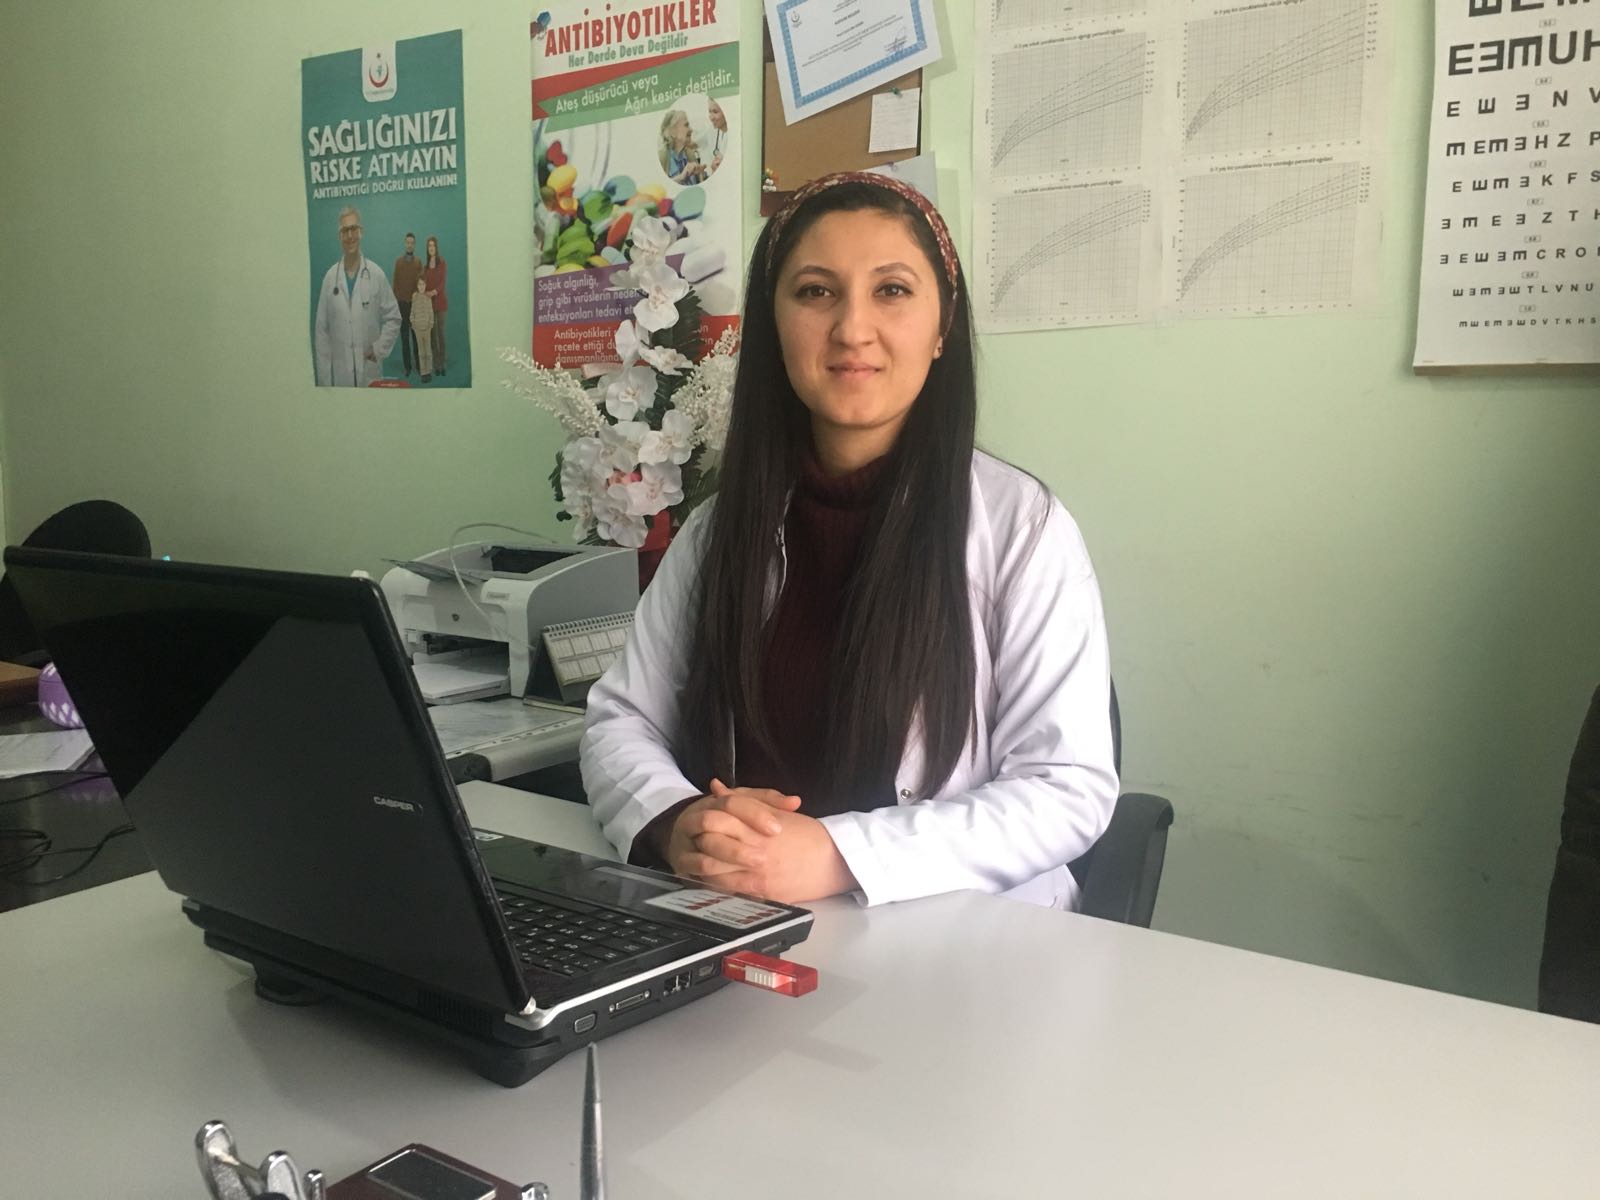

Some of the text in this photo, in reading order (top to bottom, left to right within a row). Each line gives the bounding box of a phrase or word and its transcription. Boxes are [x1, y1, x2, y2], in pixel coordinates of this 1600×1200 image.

[568, 32, 688, 68] Her Derde Deva Değildir
[556, 74, 658, 114] Ateş düşürücü veya
[624, 69, 735, 114] Ağrı kesici değildir.
[308, 107, 456, 157] SAĞLIĞINIZI
[368, 144, 457, 178] ATMAYIN
[372, 180, 404, 193] DOĞRU
[407, 174, 458, 190] KULLANIN!
[538, 274, 599, 294] Soğuk algınlığı,
[538, 296, 554, 310] grip
[556, 292, 571, 308] gibi
[574, 290, 610, 303] virüslerin
[596, 304, 622, 318] tedavi
[554, 327, 611, 341] Antibiyotikleri
[554, 342, 580, 353] reçete
[583, 340, 604, 352] ettiği
